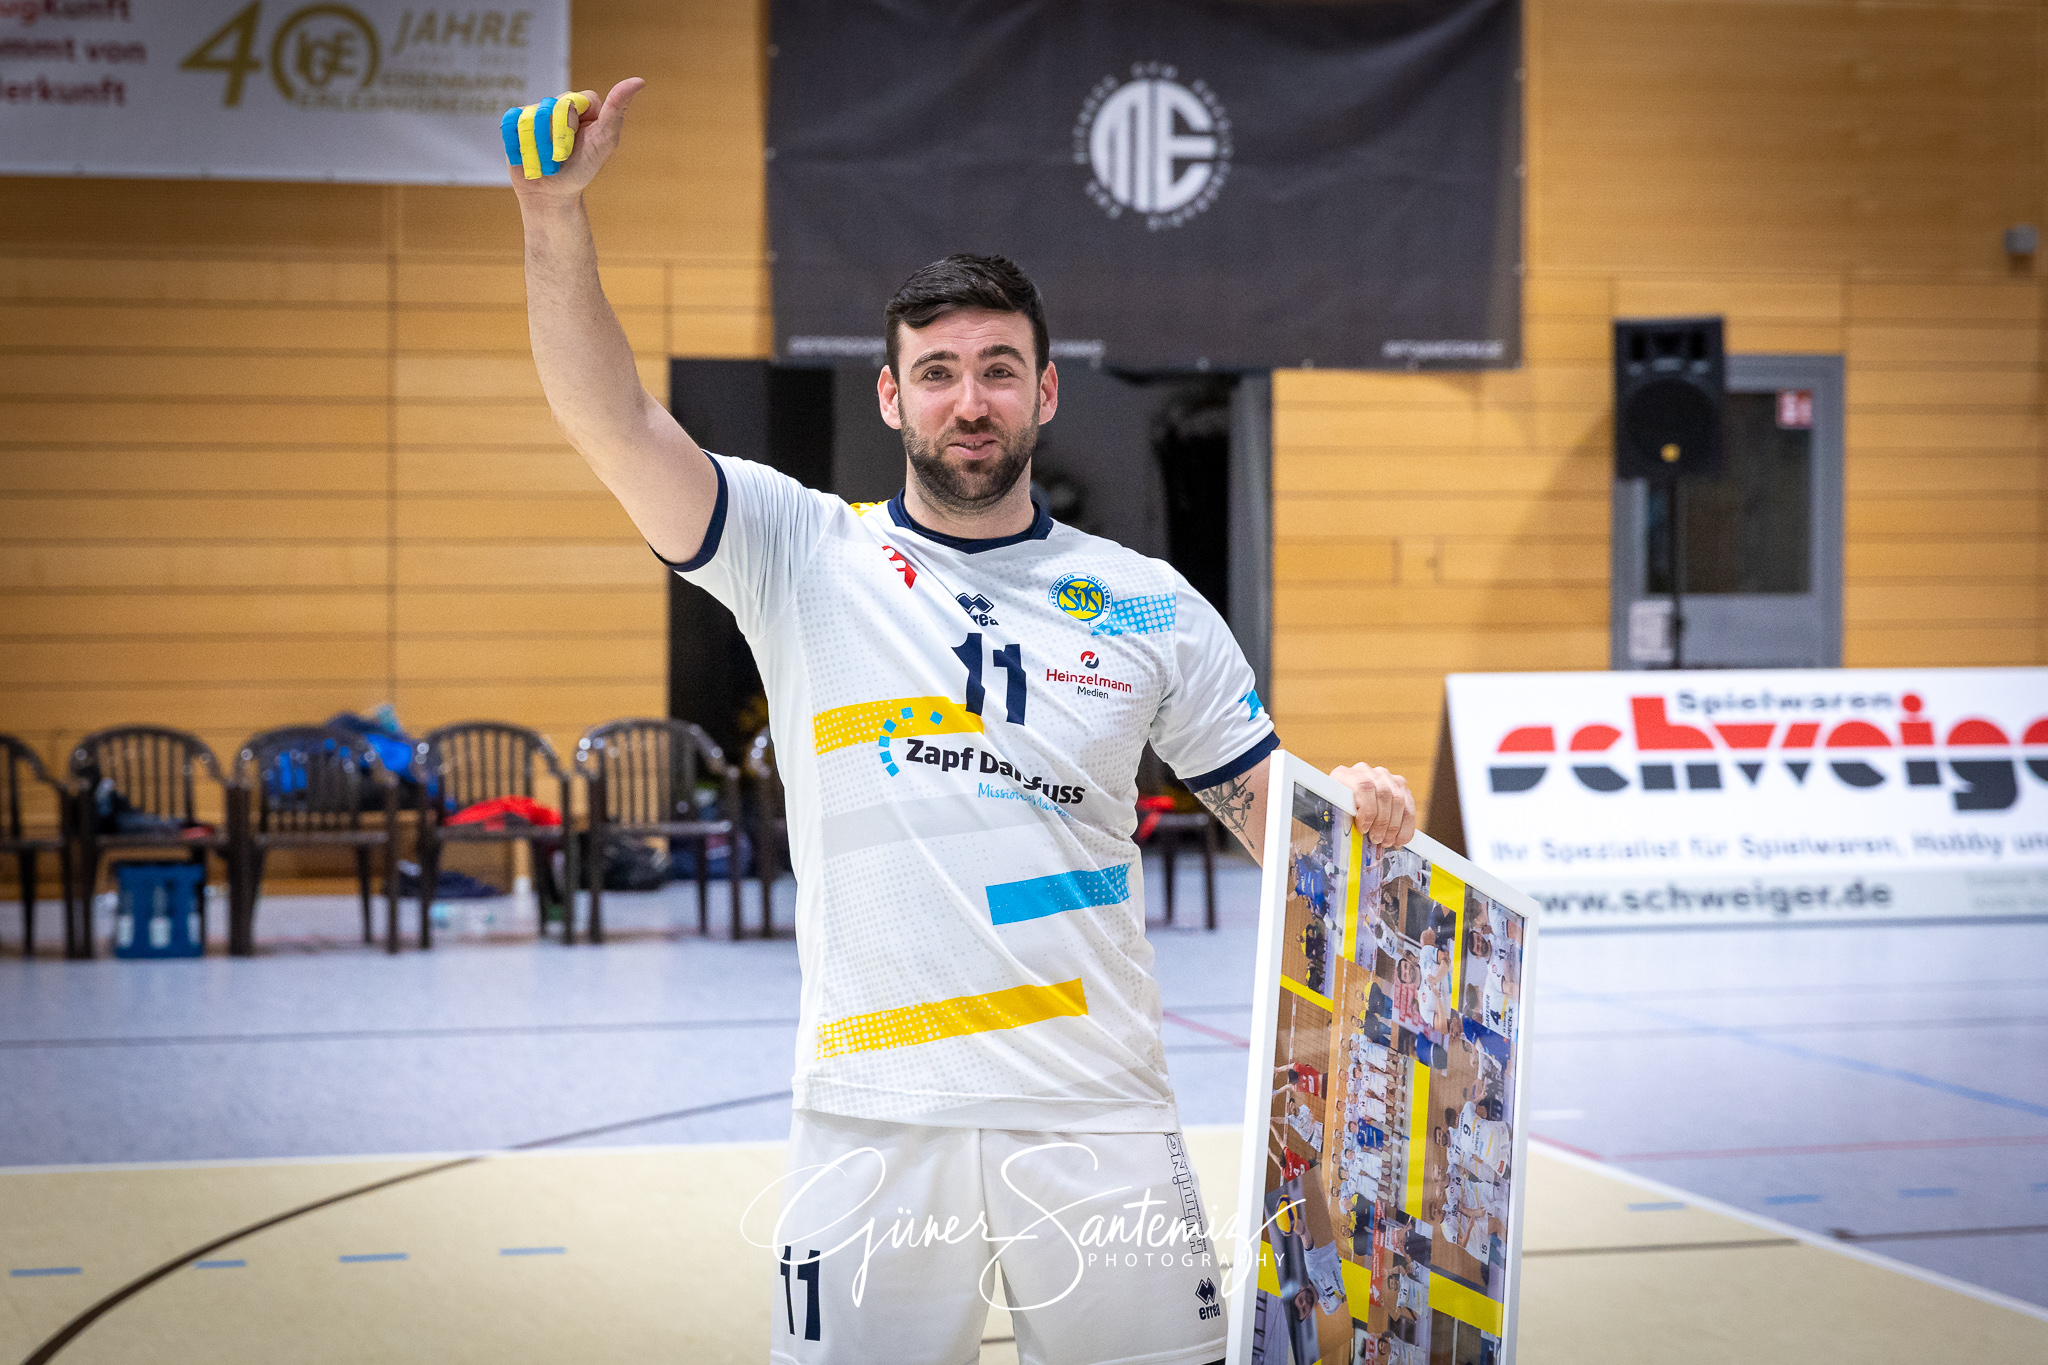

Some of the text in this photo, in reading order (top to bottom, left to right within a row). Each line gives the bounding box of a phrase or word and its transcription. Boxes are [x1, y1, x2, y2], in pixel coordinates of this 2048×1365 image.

[392, 8, 535, 56] JAHRE
[0, 74, 126, 107] erkunft
[951, 632, 1027, 727] 11
[1046, 668, 1132, 693] Heinzelmann
[1077, 685, 1109, 699] Medien
[1677, 689, 1894, 715] Spielwaren
[906, 738, 1086, 804] Zapf Dafuss
[978, 782, 1024, 800] Mission
[1490, 1009, 1501, 1026] 4
[1463, 1123, 1471, 1137] 9
[780, 1245, 821, 1341] 11
